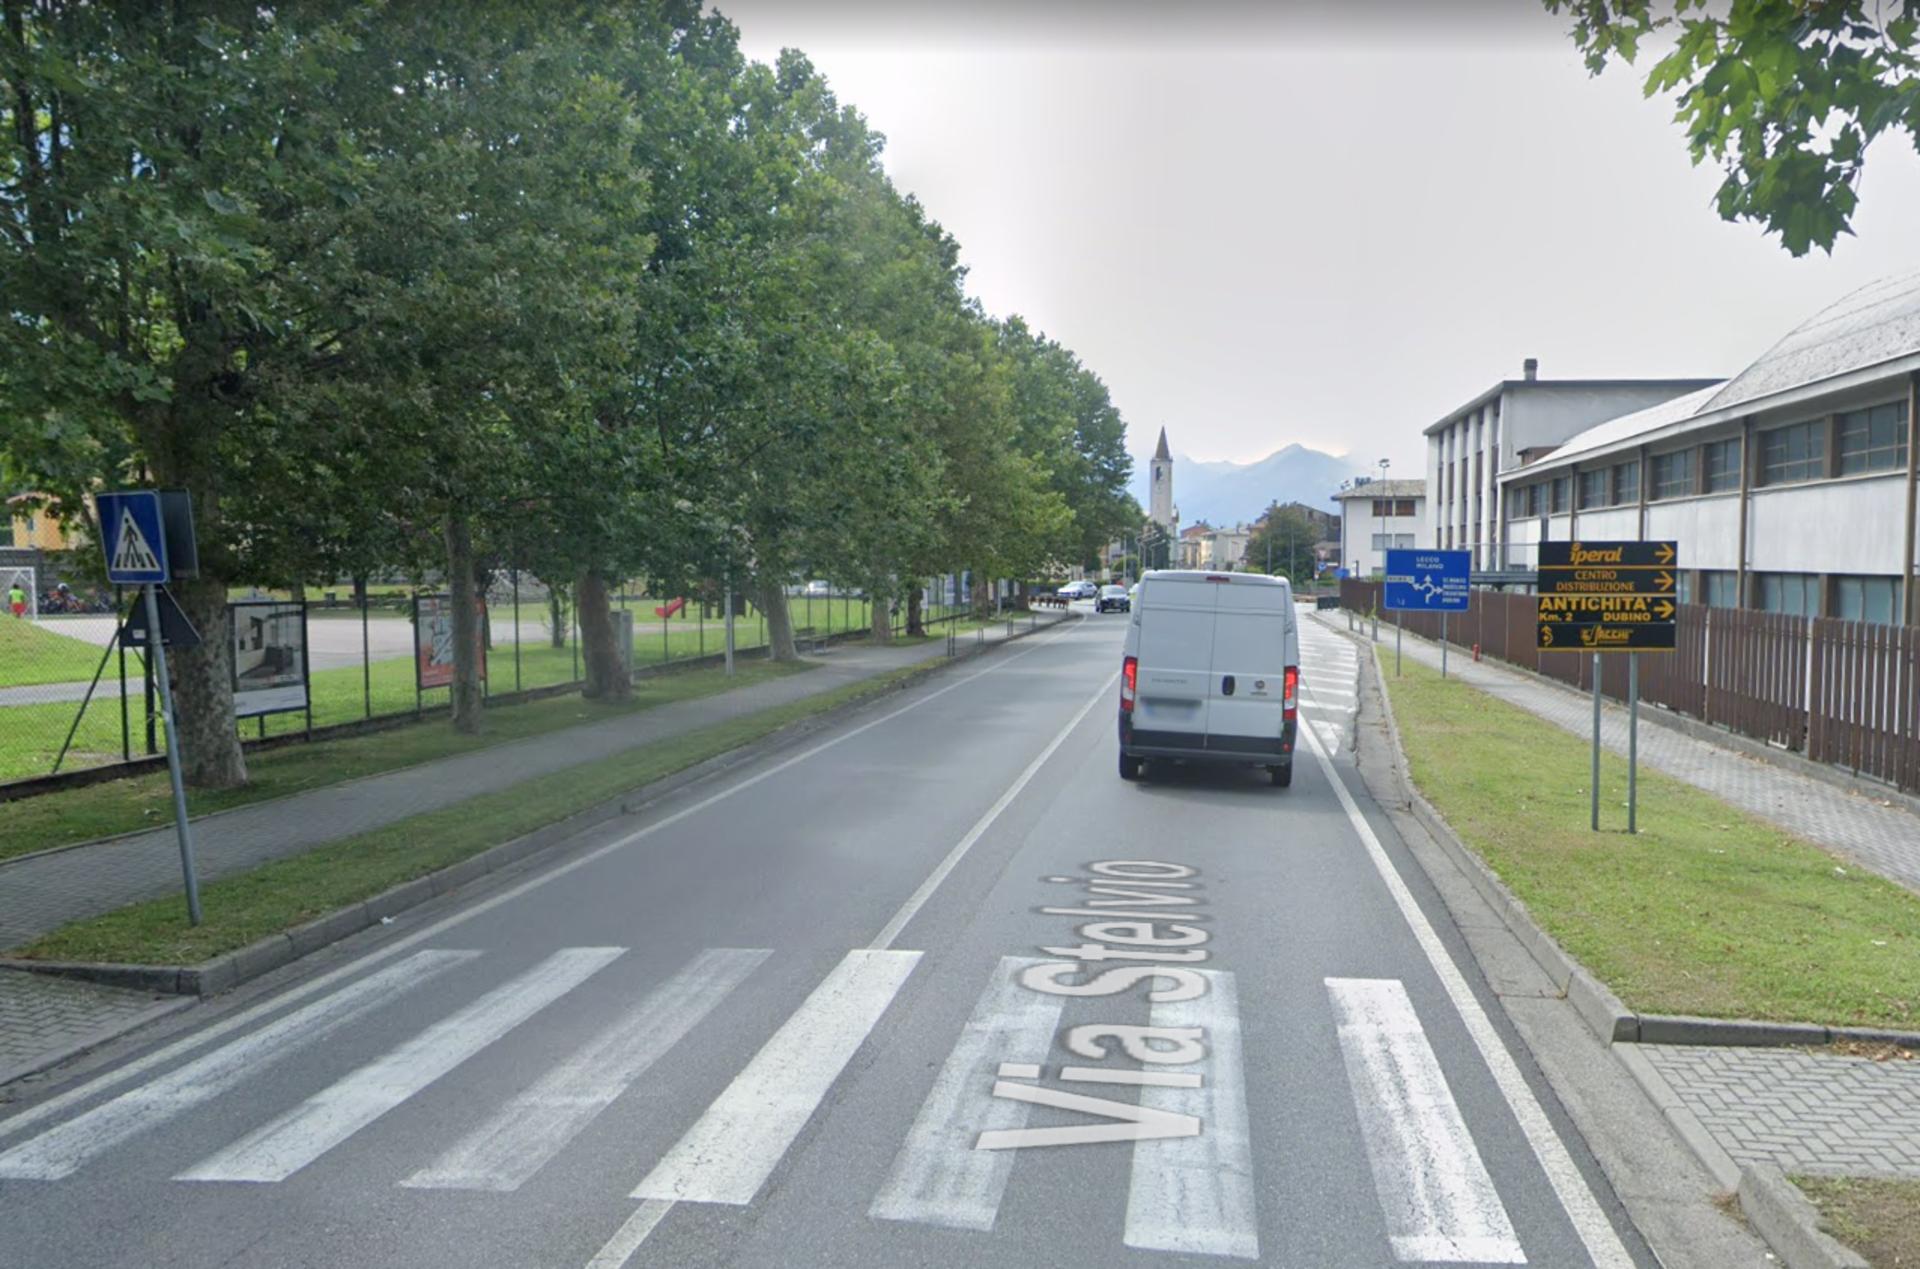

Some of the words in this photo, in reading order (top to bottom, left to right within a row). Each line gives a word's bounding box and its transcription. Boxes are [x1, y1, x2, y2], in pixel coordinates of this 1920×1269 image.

[1569, 542, 1623, 566] iperal
[1575, 570, 1617, 580] CENTRO
[1556, 581, 1635, 592] DISTRIBUZIONE
[1540, 596, 1652, 611] ANTICHITA'
[1539, 612, 1562, 622] Km.
[1565, 612, 1574, 622] 2
[1603, 612, 1652, 622] DUBINO
